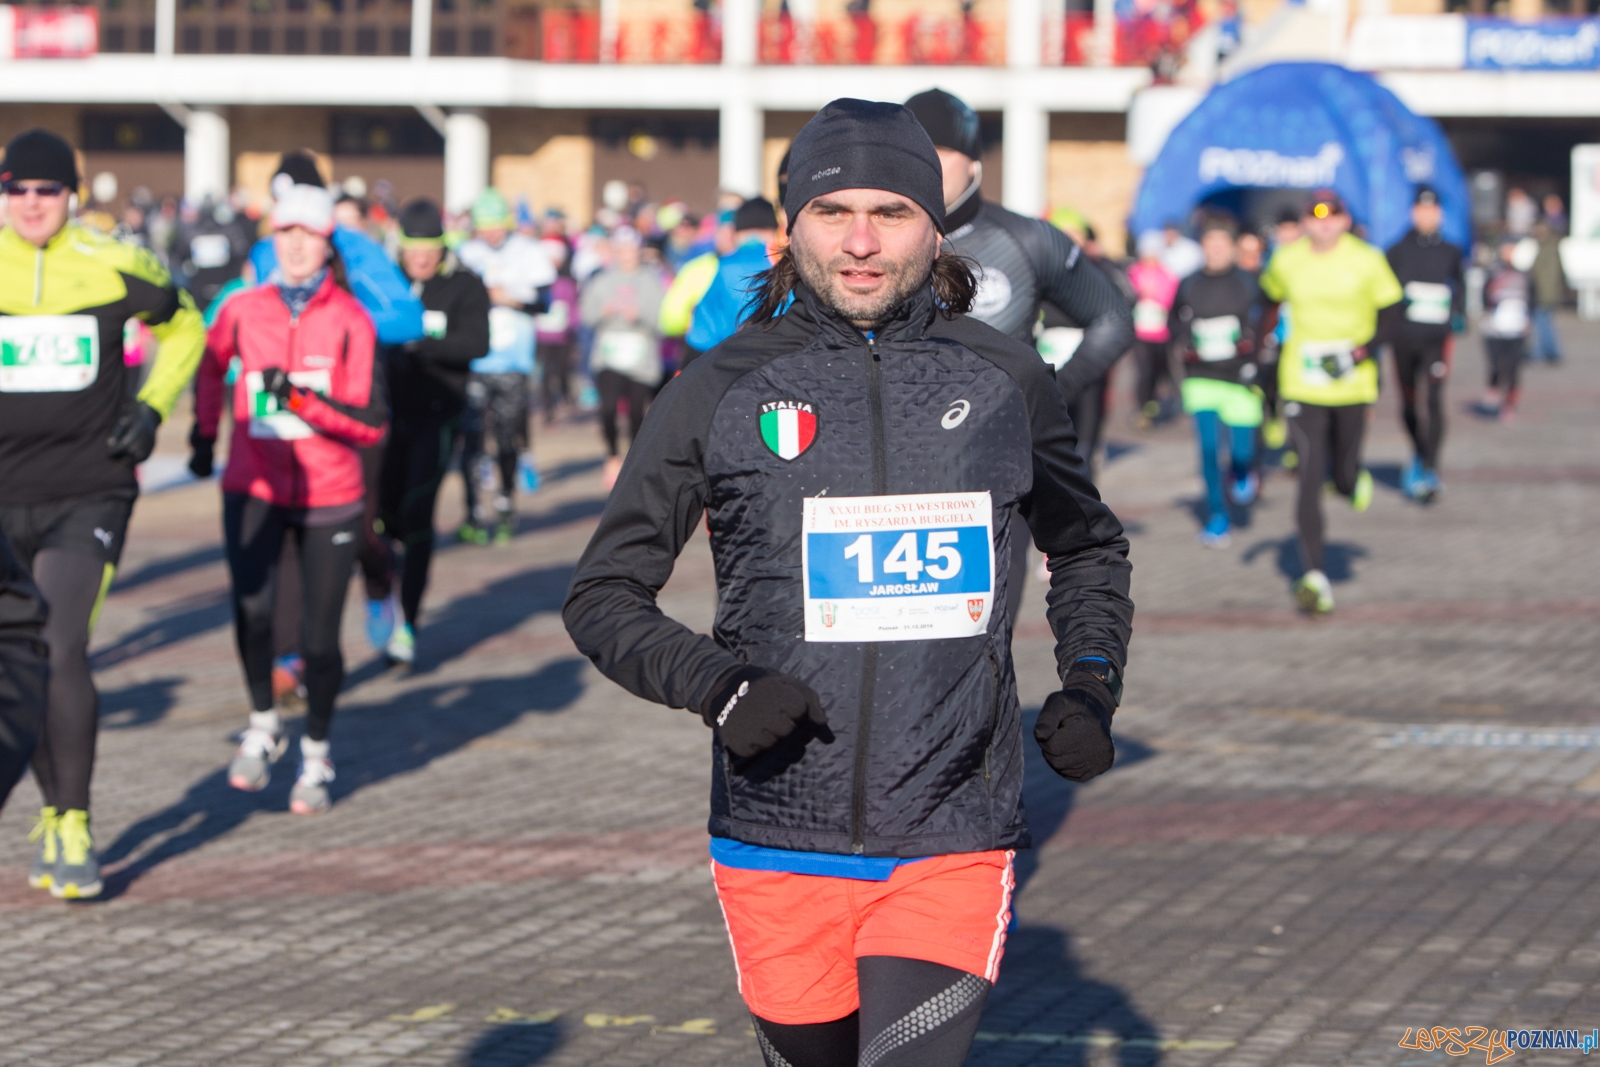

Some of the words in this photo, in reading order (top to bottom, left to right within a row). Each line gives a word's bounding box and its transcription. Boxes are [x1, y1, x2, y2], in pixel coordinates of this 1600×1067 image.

[762, 400, 812, 413] ITALIA
[864, 504, 892, 514] BIEG
[895, 500, 977, 513] SYLWESTROWY
[855, 516, 917, 528] RYSZARDA
[920, 513, 974, 525] BURGIELA
[844, 531, 962, 583] 145
[869, 582, 939, 596] JAROSŁAW
